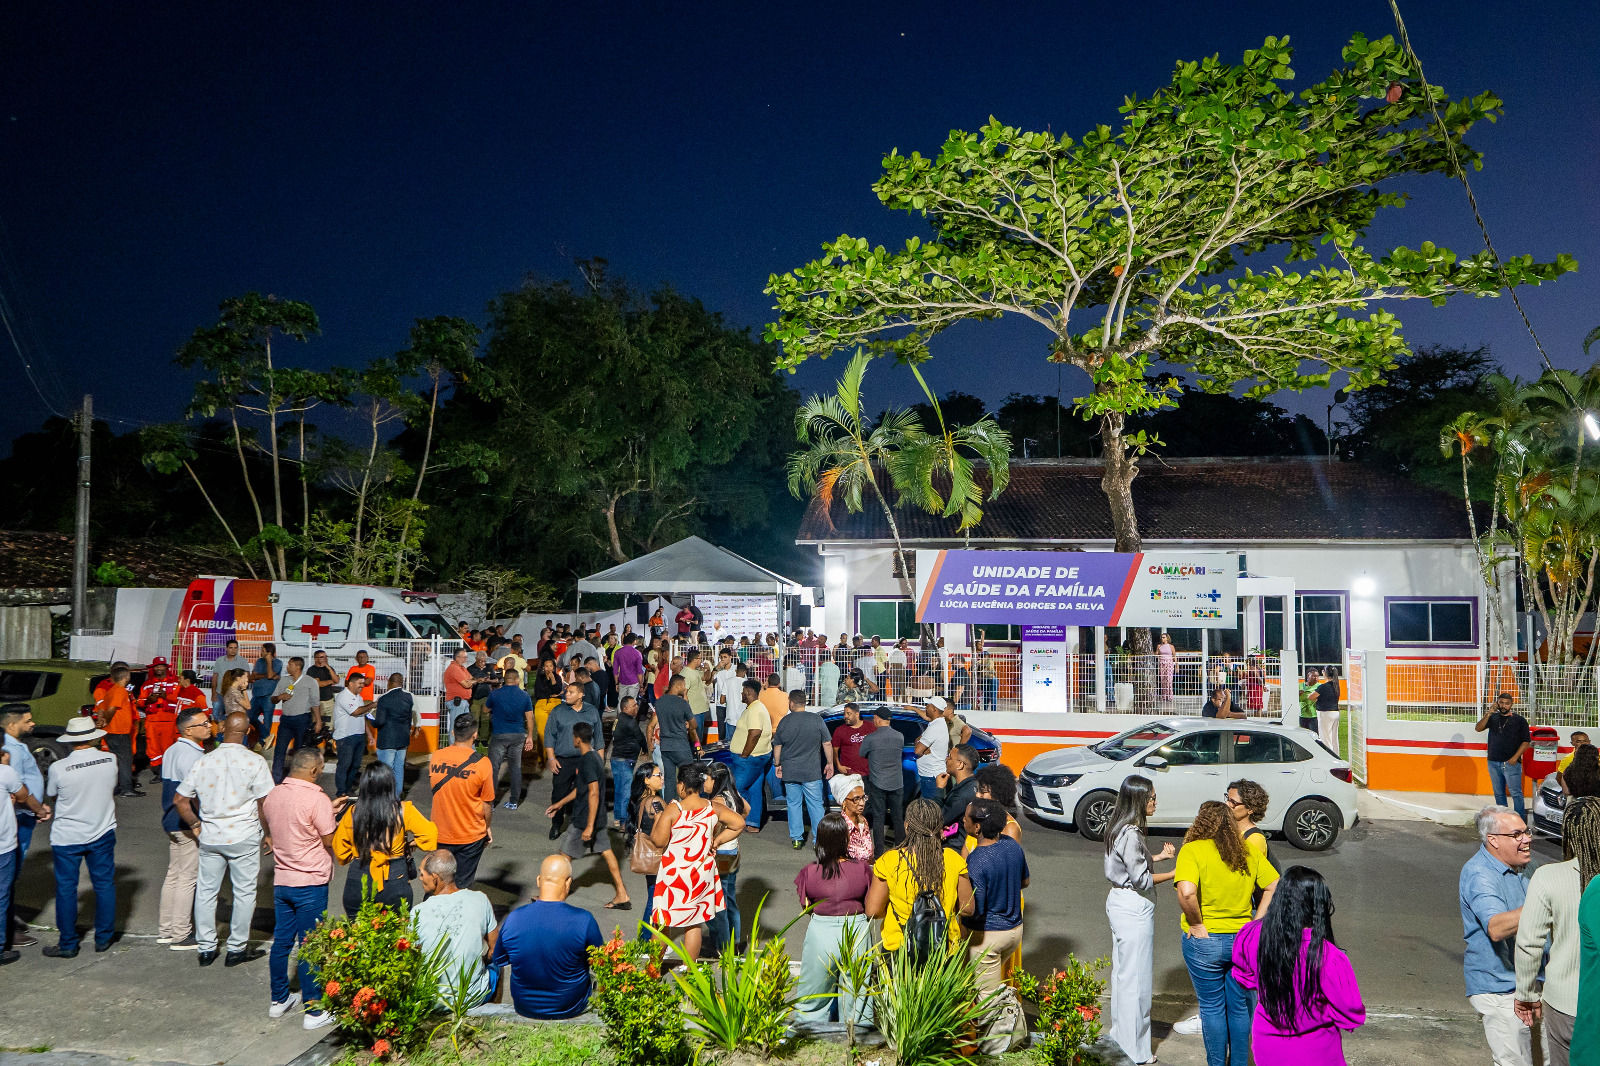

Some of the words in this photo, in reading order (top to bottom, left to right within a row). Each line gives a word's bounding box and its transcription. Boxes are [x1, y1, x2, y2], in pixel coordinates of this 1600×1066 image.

[972, 565, 1052, 579] UNIDADE
[1055, 567, 1080, 579] DE
[1149, 566, 1206, 577] CAMAÇARI
[942, 581, 1002, 596] SAÚDE
[1005, 584, 1030, 597] DA
[1035, 581, 1106, 598] FAMÍLIA
[939, 598, 969, 609] LÚCIA
[971, 599, 1014, 610] EUGÊNIA
[1016, 602, 1056, 610] BORGES
[1058, 602, 1073, 610] DA
[1075, 602, 1105, 611] SILVA
[190, 619, 267, 632] AMBULÂNCIA
